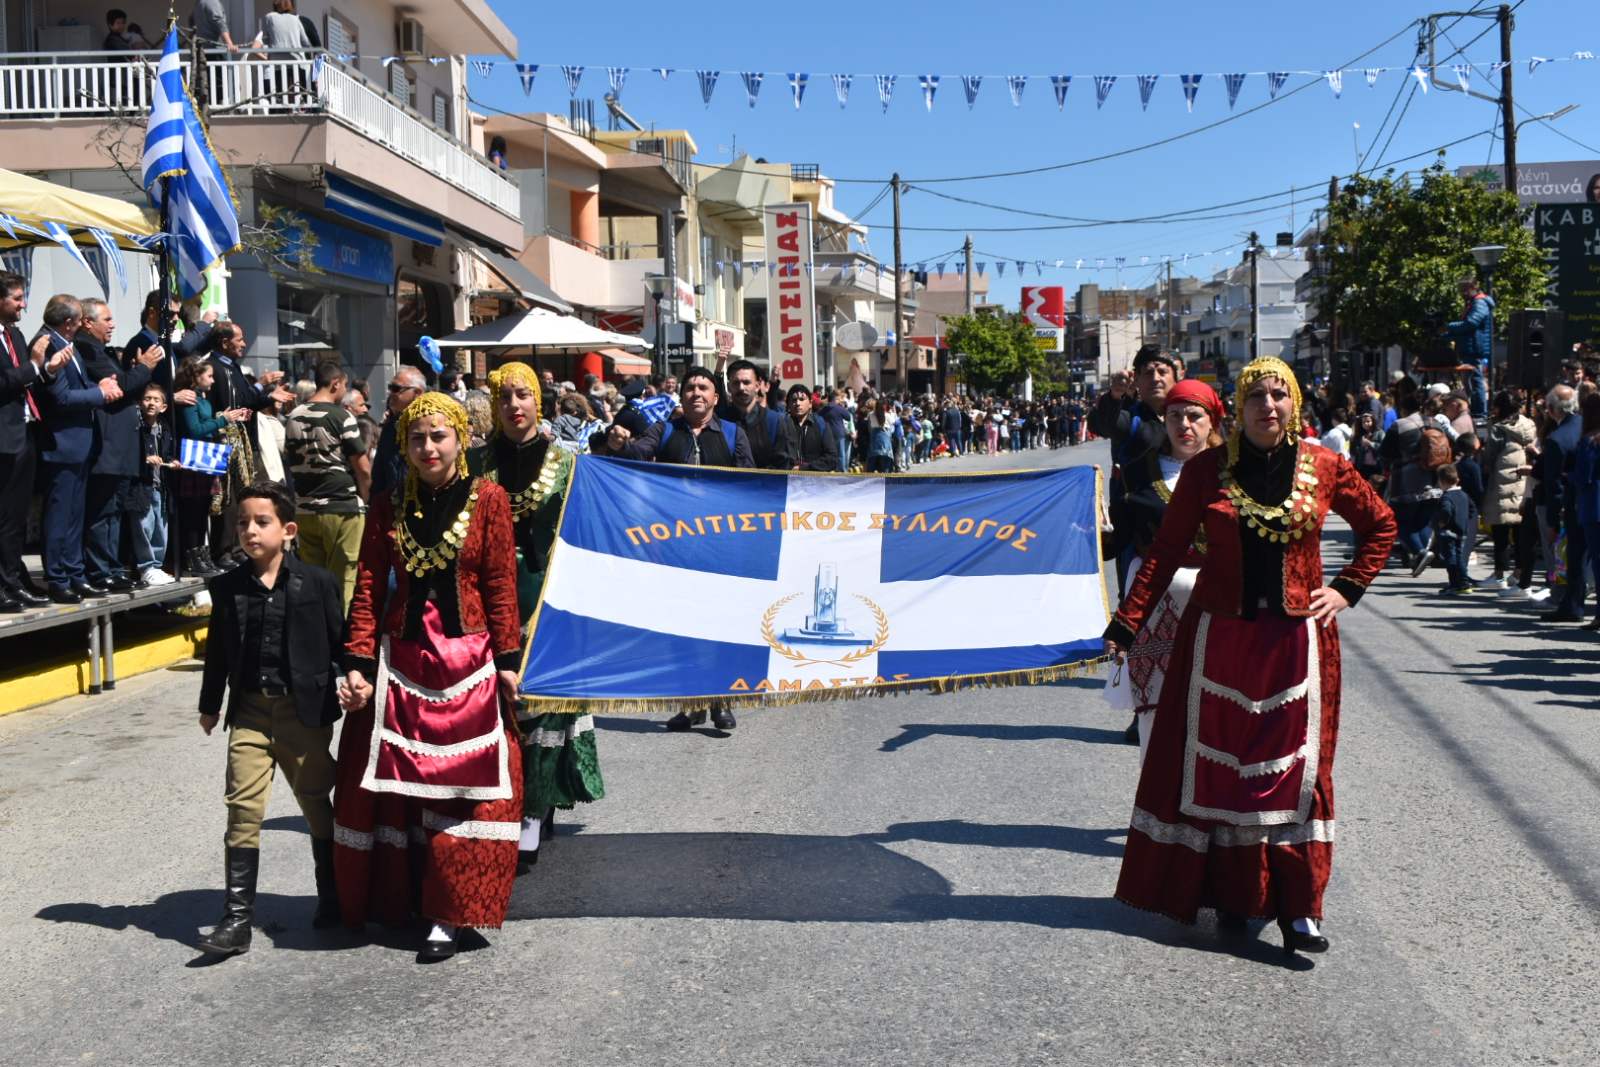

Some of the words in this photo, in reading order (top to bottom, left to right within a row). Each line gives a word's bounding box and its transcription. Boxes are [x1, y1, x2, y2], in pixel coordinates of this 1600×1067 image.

[1516, 168, 1550, 184] λένη
[1516, 178, 1583, 196] ατσινά
[776, 211, 804, 379] ΒΑΤΣΙΝΑΣ
[624, 511, 857, 545] ΠΟΛΙΤΙΣΤΙΚΟΣ
[867, 512, 1038, 551] ΣΥΛΛΟΓΟΣ
